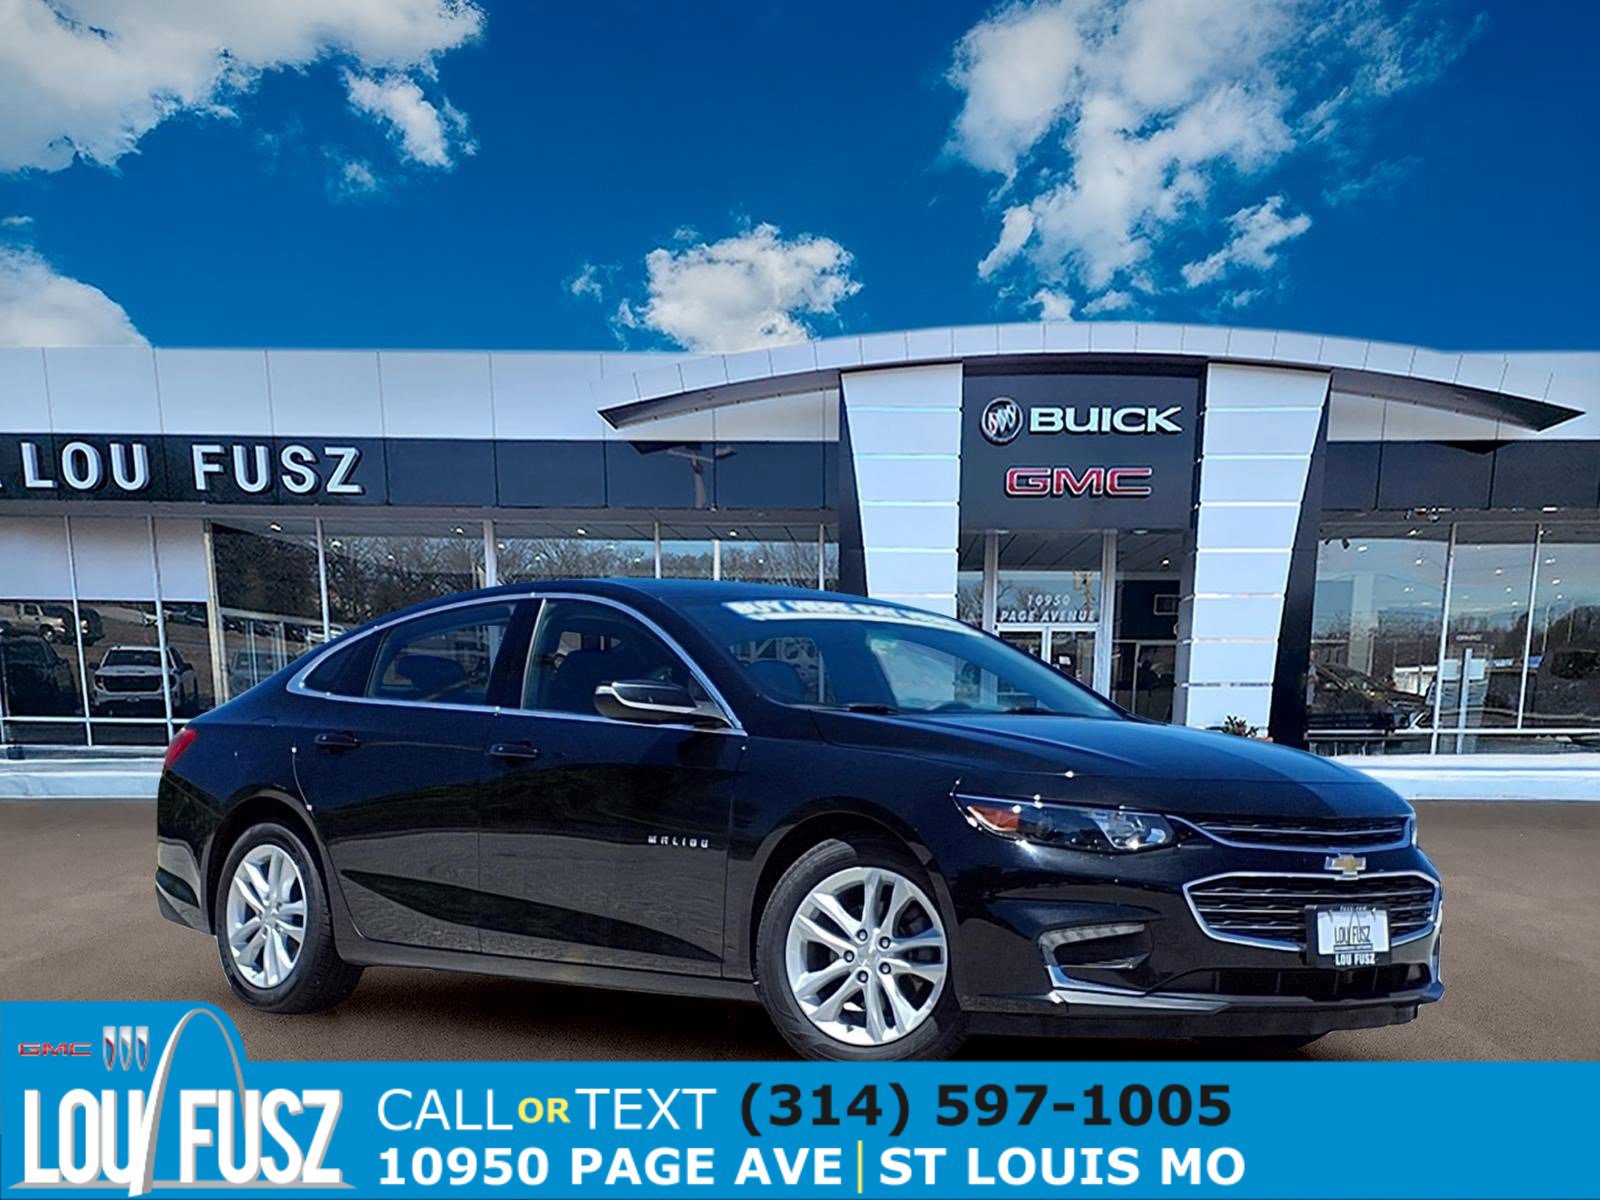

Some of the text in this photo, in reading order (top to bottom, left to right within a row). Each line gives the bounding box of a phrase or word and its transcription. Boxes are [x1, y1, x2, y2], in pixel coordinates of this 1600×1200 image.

[1029, 406, 1183, 435] BUICK
[20, 441, 364, 495] LOU FUSZ
[1005, 467, 1153, 497] GMC
[1027, 594, 1072, 607] 10950
[1000, 609, 1036, 623] PAGE
[1041, 609, 1096, 623] AVENUE
[1334, 925, 1371, 944] LOU FUSZ
[1335, 953, 1376, 966] LOU FUSZ
